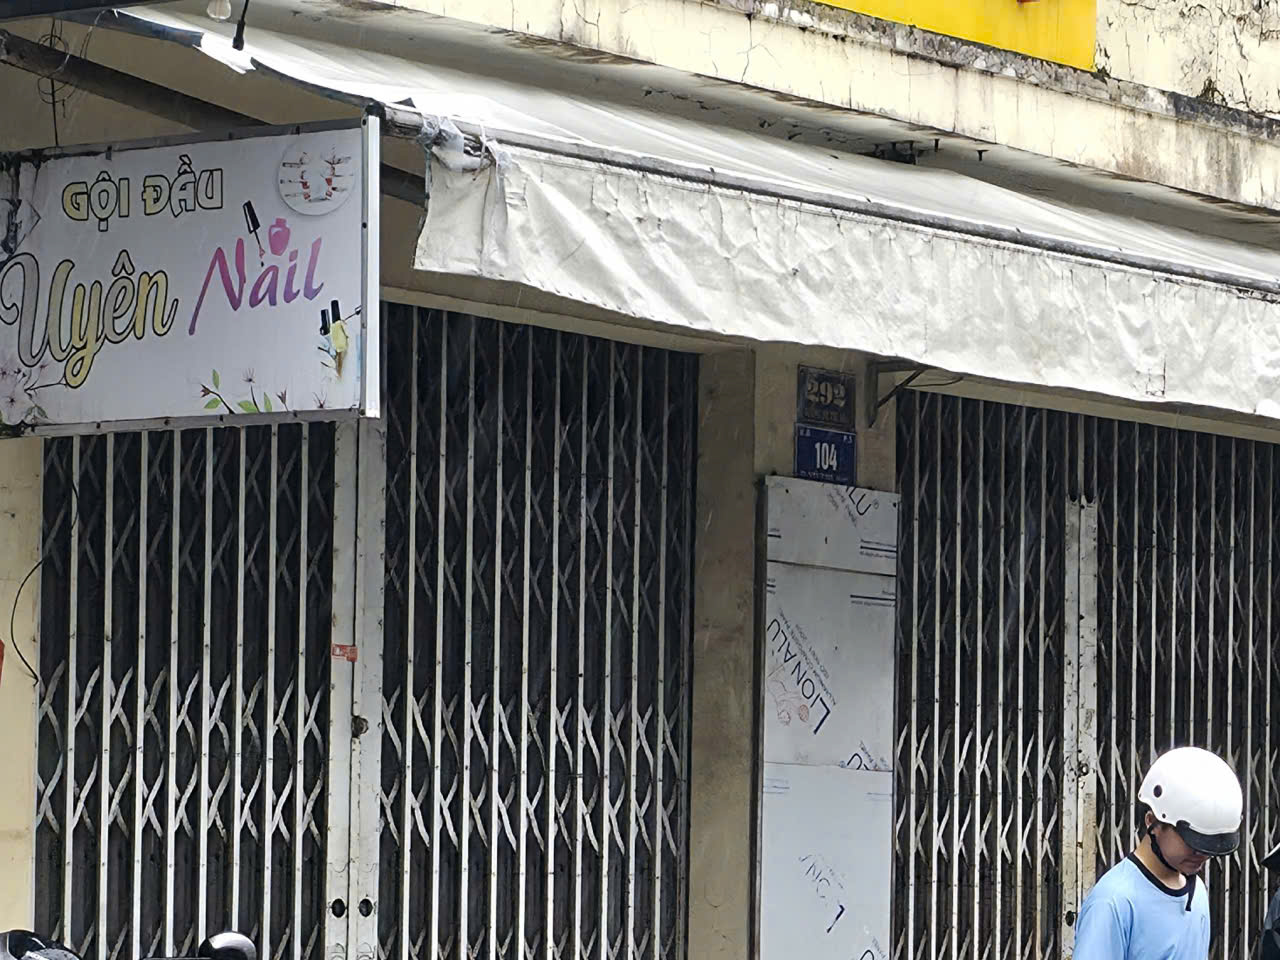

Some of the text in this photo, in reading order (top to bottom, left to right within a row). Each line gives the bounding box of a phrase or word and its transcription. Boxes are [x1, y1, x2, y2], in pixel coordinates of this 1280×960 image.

[62, 155, 223, 232] GỘI ĐẦU
[0, 237, 325, 389] Uyên Nail
[814, 442, 838, 471] 104
